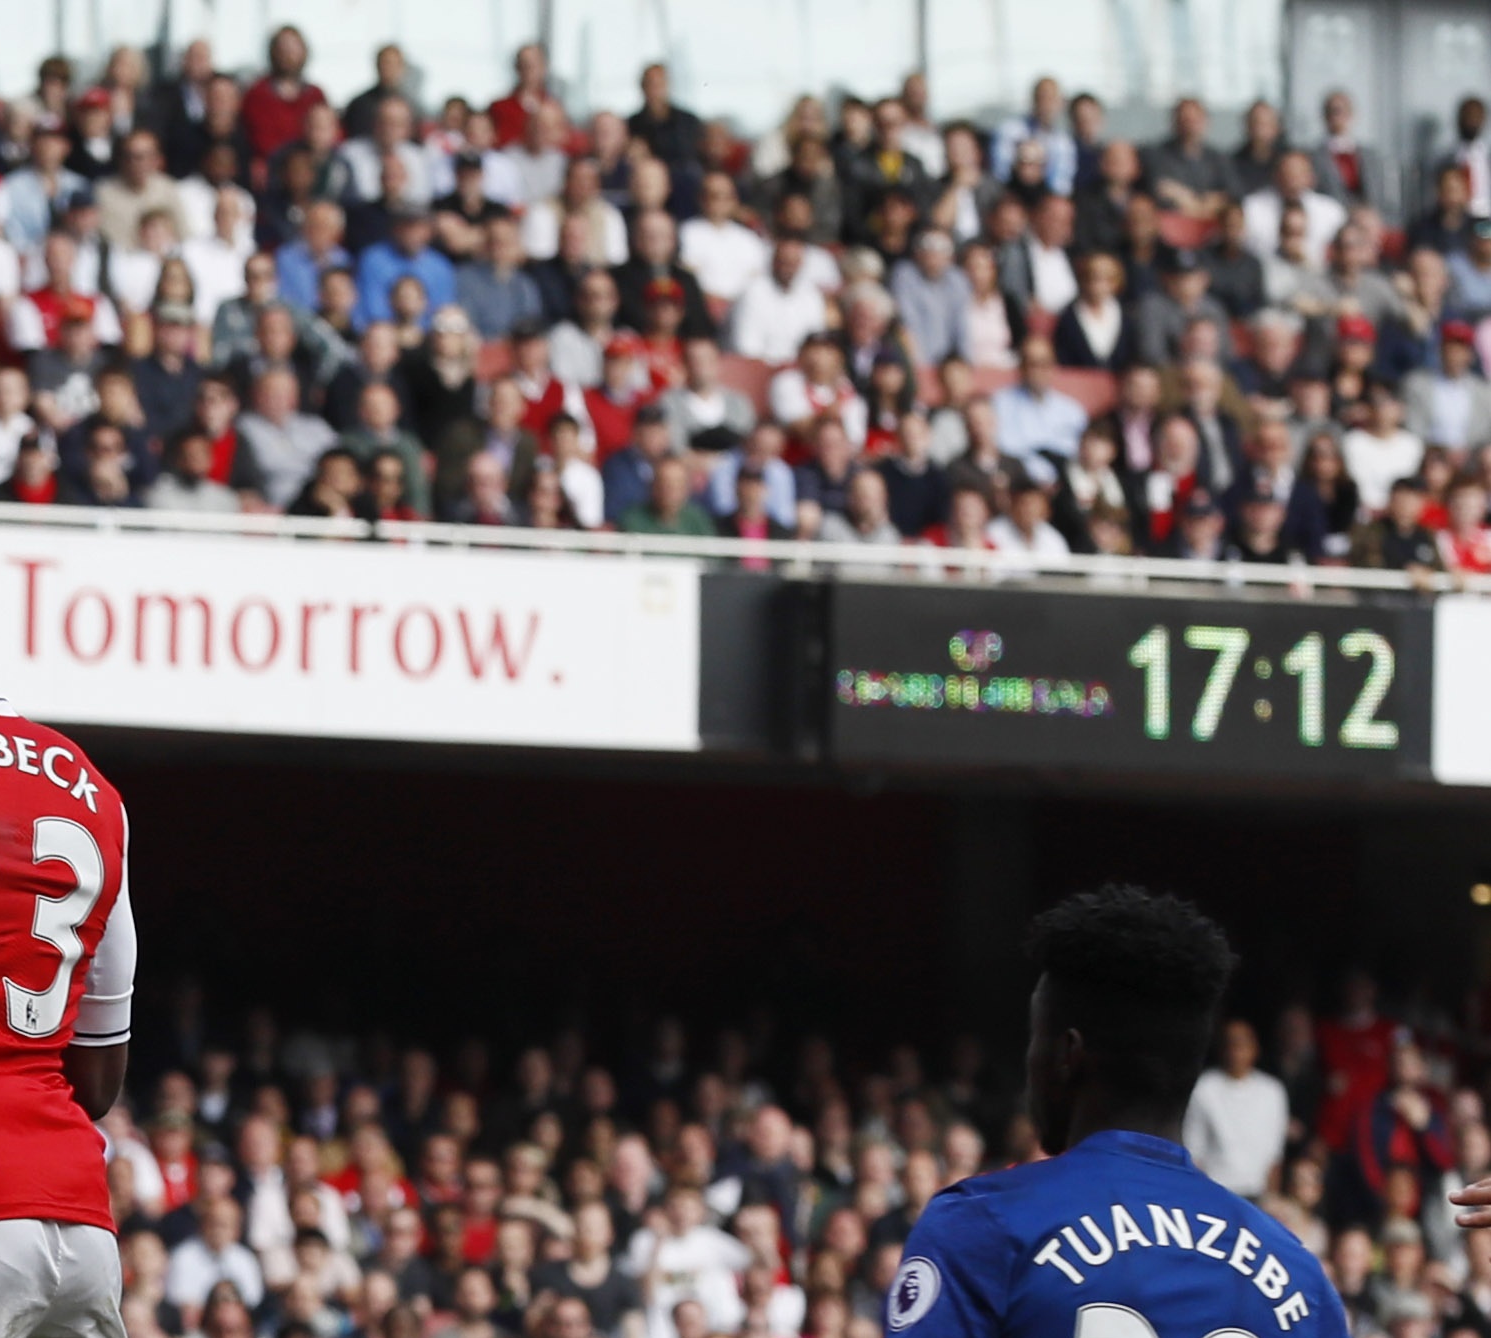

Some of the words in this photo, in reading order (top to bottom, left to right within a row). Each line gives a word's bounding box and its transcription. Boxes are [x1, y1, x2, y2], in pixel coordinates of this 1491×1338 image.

[6, 555, 565, 687] Tomorrow.
[1130, 624, 1401, 749] 17:12
[1033, 1203, 1309, 1332] TUANZEBE
